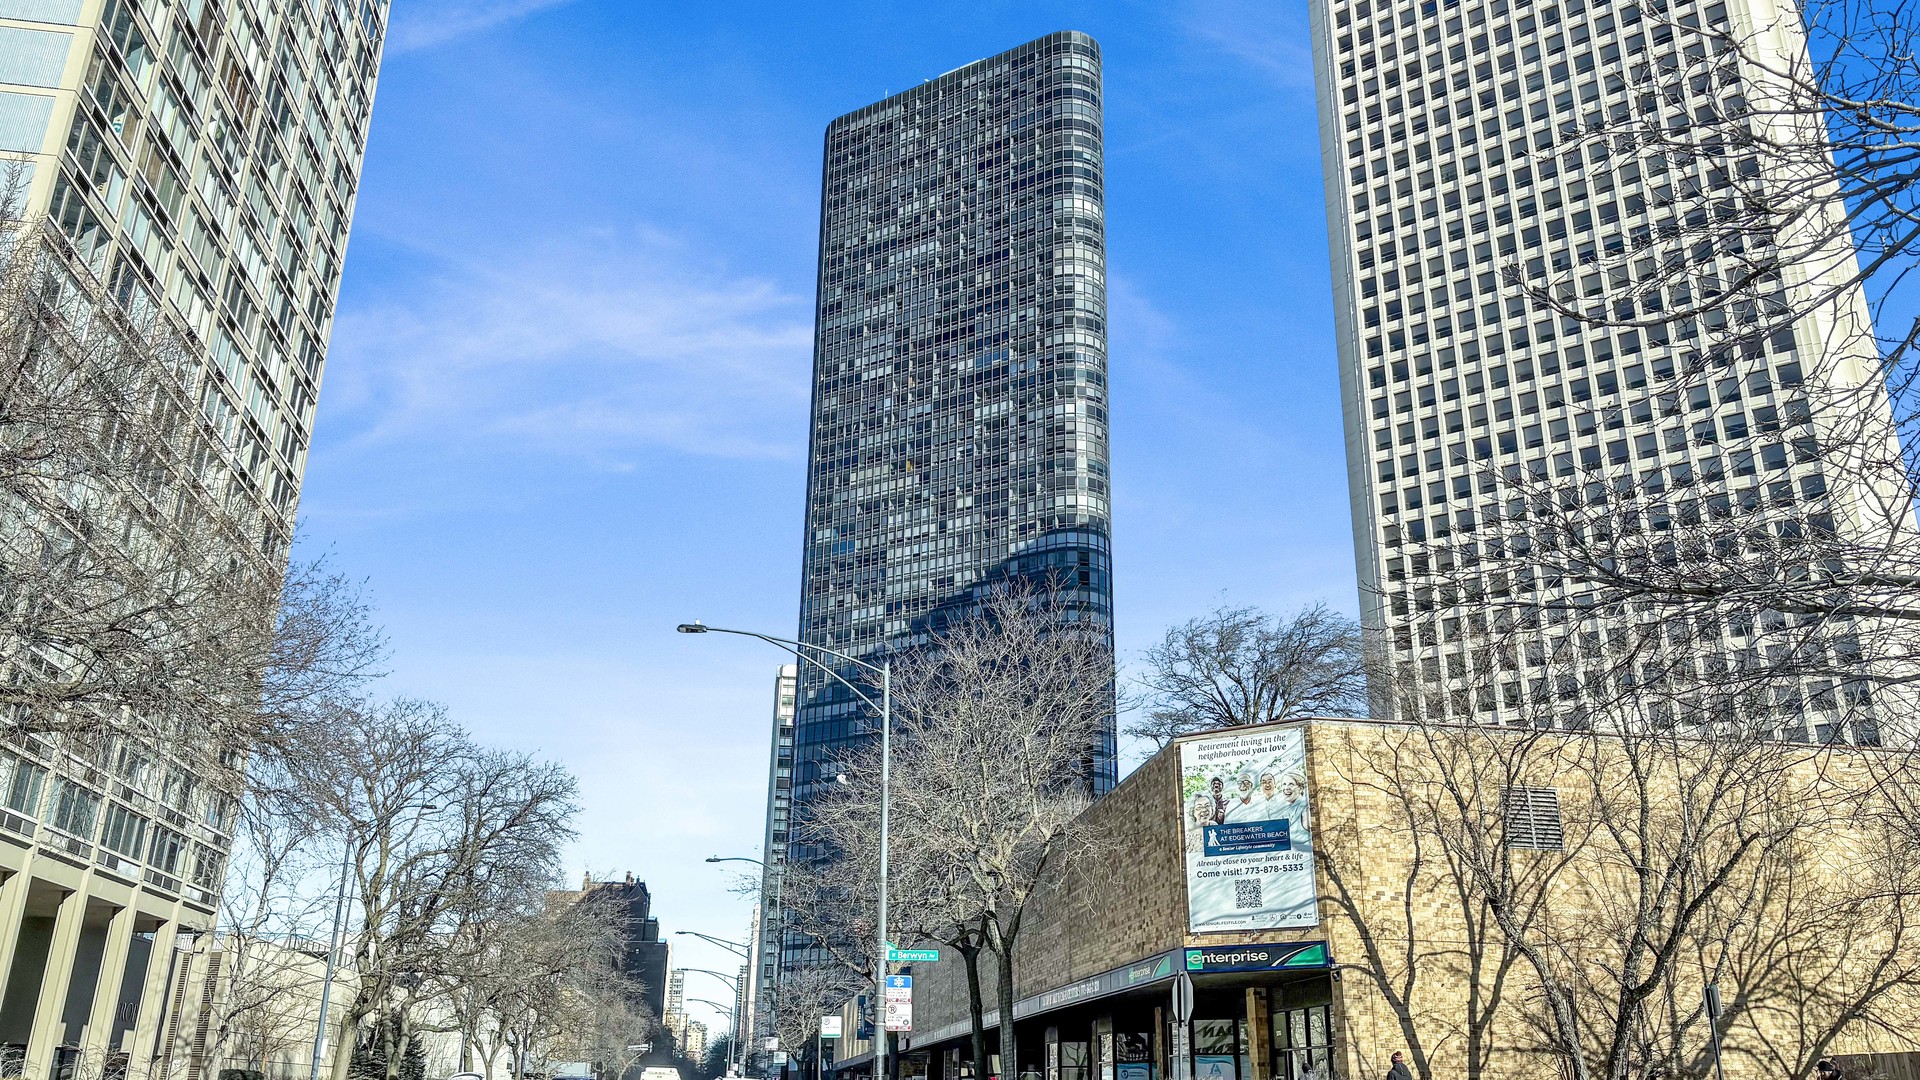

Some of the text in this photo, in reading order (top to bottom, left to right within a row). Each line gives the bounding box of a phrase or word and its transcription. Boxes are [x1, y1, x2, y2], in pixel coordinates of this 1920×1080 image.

[1198, 741, 1239, 752] Retirement
[1241, 738, 1262, 746] living
[1274, 734, 1286, 742] the
[1198, 744, 1286, 761] neighborhood you love
[1229, 833, 1266, 842] EDGEWATER
[1232, 826, 1263, 834] BREAKERS
[1196, 859, 1221, 867] Already
[1248, 857, 1264, 865] your
[1291, 852, 1303, 860] life
[1196, 863, 1304, 878] Come visit! 773-878-5333
[897, 951, 927, 960] Berwyn
[1188, 950, 1269, 965] enterprise
[1129, 966, 1151, 979] enterprise
